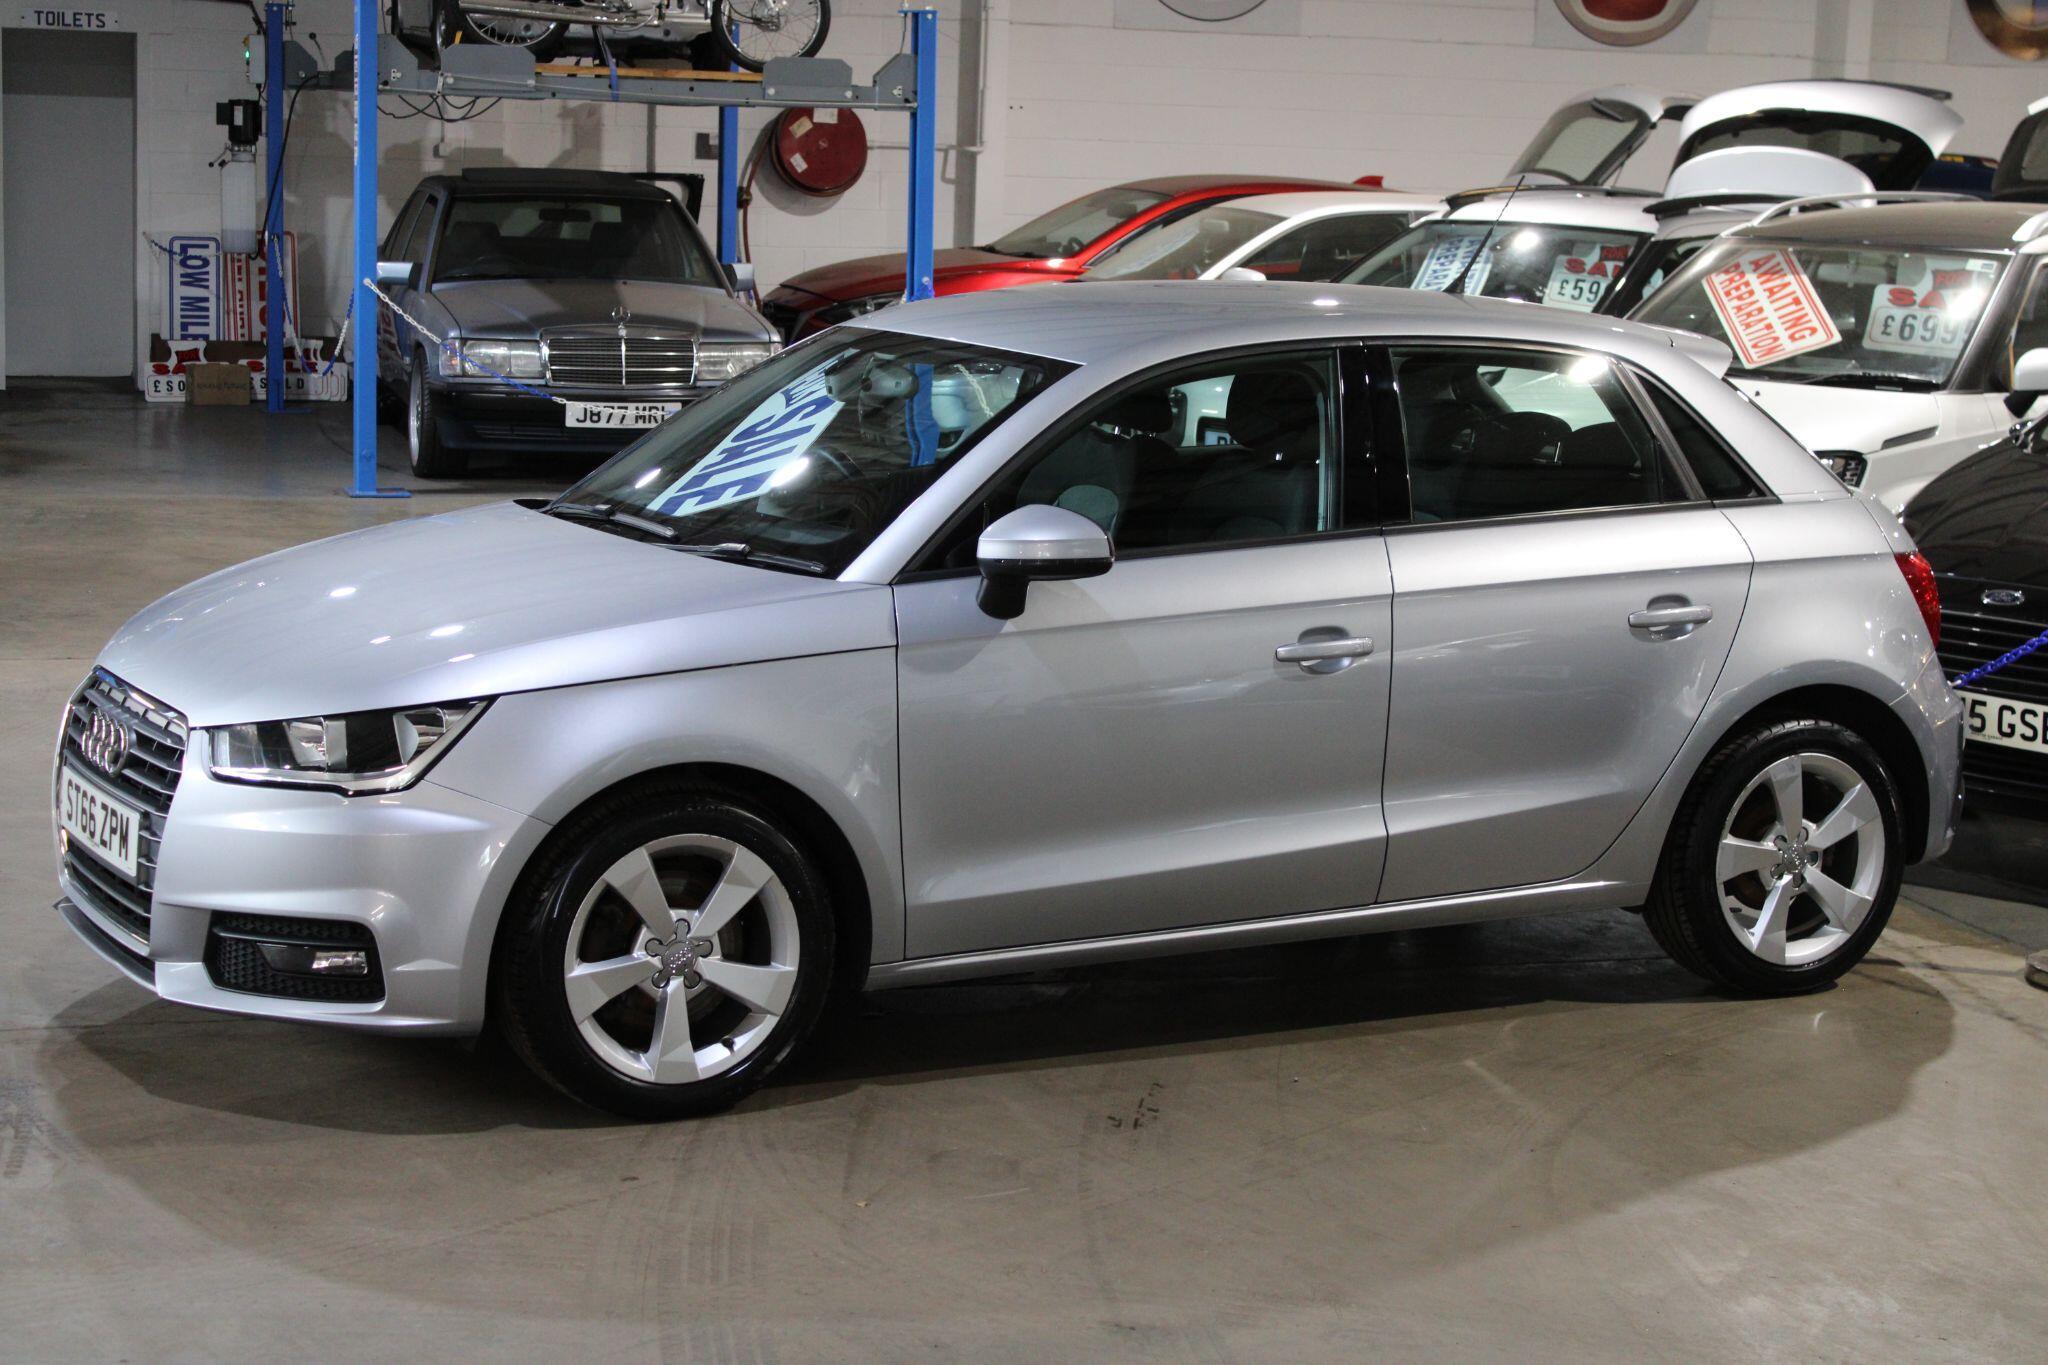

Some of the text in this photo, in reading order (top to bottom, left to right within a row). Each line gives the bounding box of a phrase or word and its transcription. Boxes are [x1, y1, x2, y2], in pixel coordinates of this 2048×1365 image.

[33, 10, 106, 28] TOILETS
[179, 243, 210, 289] LOW
[1749, 252, 1819, 343] AWAITING
[1714, 261, 1786, 360] PREPARATION
[575, 405, 629, 425] J877
[656, 395, 837, 516] SALE
[66, 778, 130, 862] ST66 ZPM
